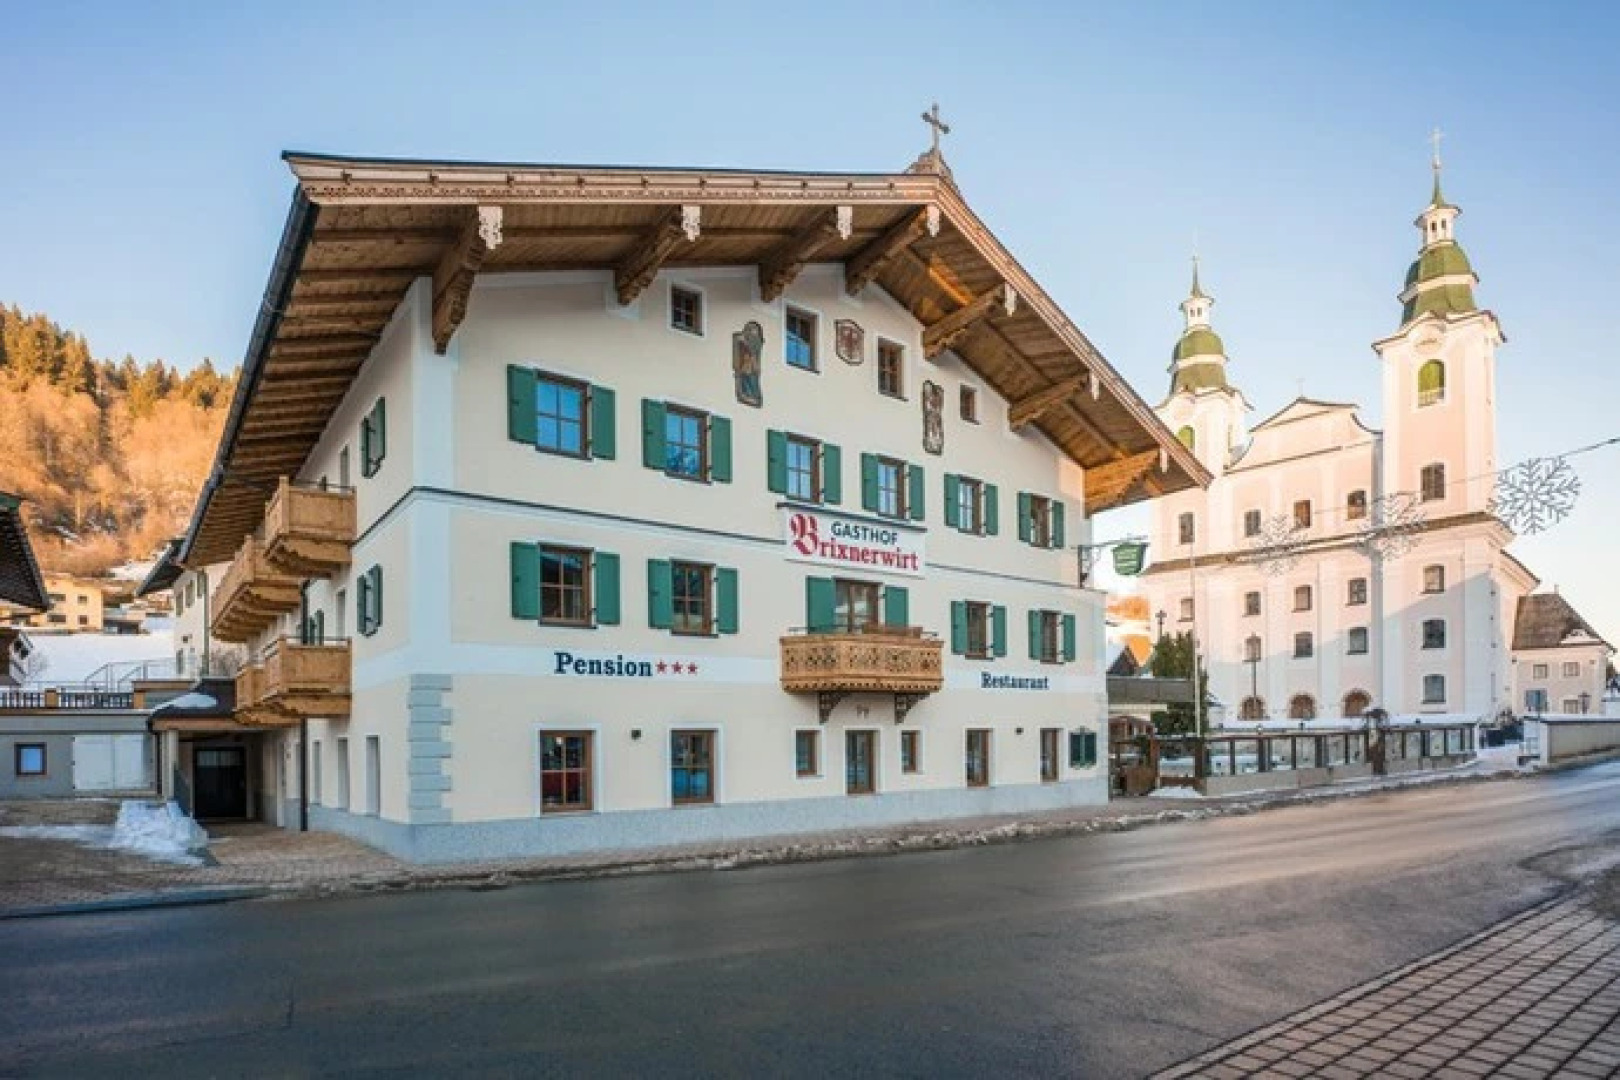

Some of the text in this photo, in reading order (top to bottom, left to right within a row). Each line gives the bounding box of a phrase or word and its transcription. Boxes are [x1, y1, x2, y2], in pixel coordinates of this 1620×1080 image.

[788, 513, 919, 571] Brixnerwirt
[830, 520, 898, 546] GASTHOF
[553, 651, 654, 676] Pension
[981, 671, 1050, 690] Restaurant
